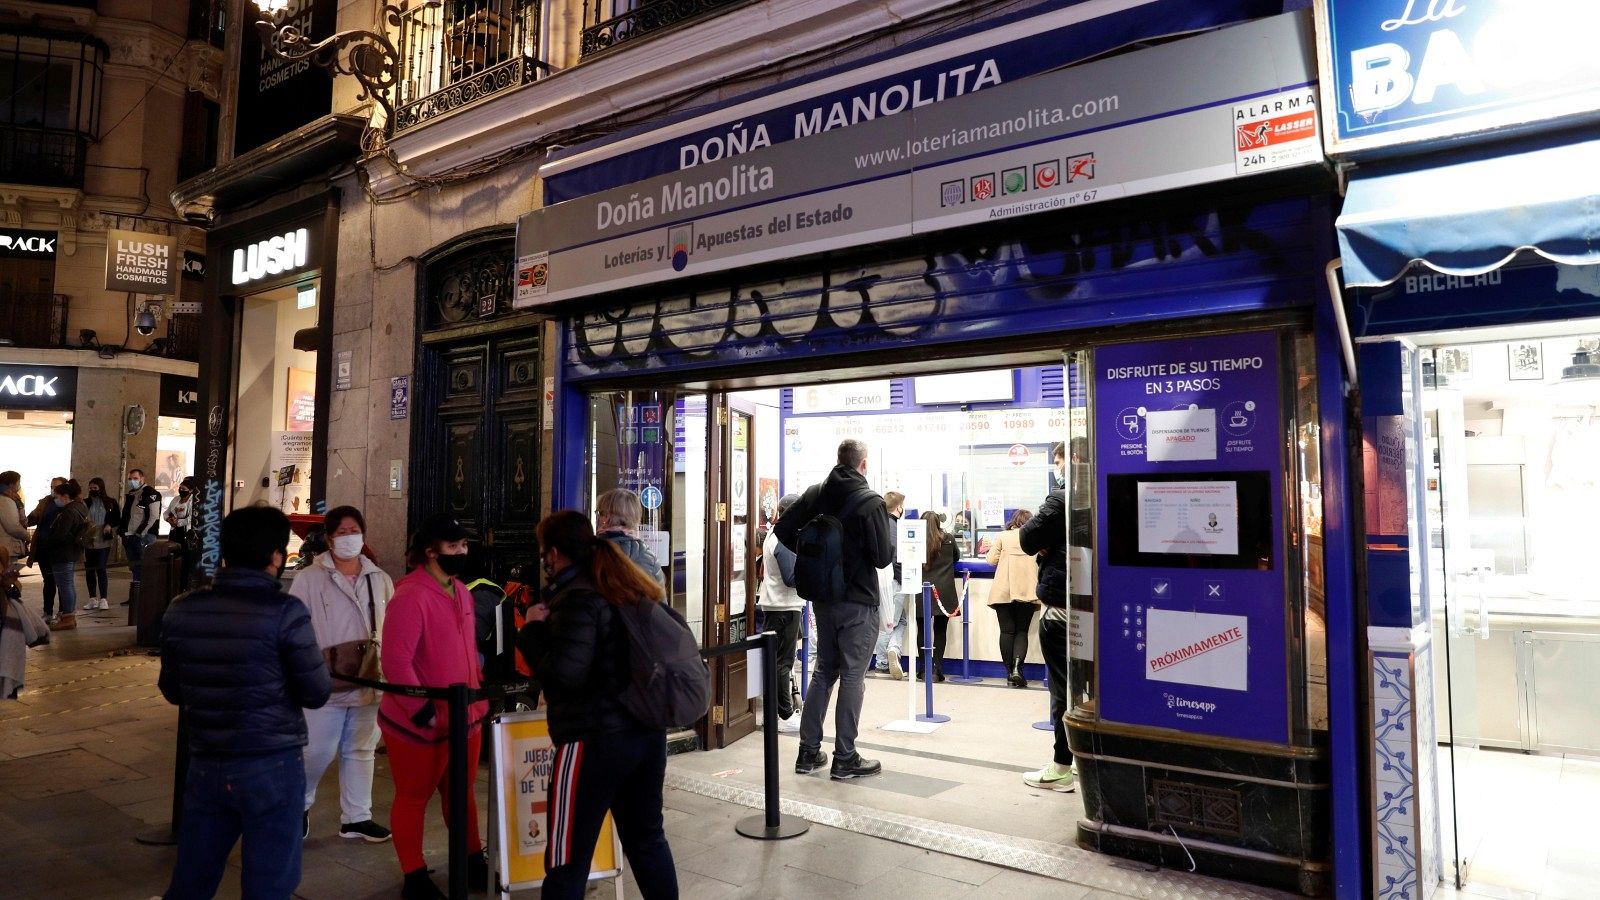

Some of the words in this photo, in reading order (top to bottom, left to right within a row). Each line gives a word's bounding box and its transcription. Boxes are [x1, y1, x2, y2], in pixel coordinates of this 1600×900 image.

[259, 57, 310, 92] COSMETICS
[680, 122, 772, 170] DOÑA
[794, 58, 1002, 139] MANOLITA
[1236, 95, 1315, 120] ALARMA
[854, 95, 1119, 169] www.loteriamanolita.com
[1274, 117, 1313, 133] LASSER
[1243, 154, 1266, 167] 24h
[597, 193, 654, 230] Doña
[661, 165, 774, 214] Manolita
[989, 197, 1066, 218] Administración
[1083, 190, 1098, 201] 67
[604, 246, 654, 269] Loterías
[656, 246, 665, 262] y
[696, 224, 763, 250] Apuestas
[768, 214, 791, 235] del
[796, 204, 853, 229] Estado
[117, 240, 169, 257] LUSH
[232, 228, 308, 285] LUSH
[116, 254, 169, 270] FRESH
[116, 266, 168, 277] HANDMADE
[116, 274, 167, 285] COSMETICS
[481, 298, 492, 312] 22
[1107, 363, 1166, 380] DISFRUTE
[1169, 363, 1187, 375] DE
[1190, 361, 1208, 374] SU
[1211, 357, 1263, 372] TIEMPO
[1146, 382, 1162, 394] EN
[1166, 380, 1173, 393] 3
[1177, 378, 1221, 392] PASOS
[1003, 419, 1034, 429] 10989
[651, 477, 662, 485] del
[1136, 605, 1142, 613] 2
[1136, 630, 1142, 638] 8
[1150, 627, 1242, 671] PRÓXIMAMENTE
[1176, 696, 1216, 713] timesapp
[521, 780, 535, 794] DE
